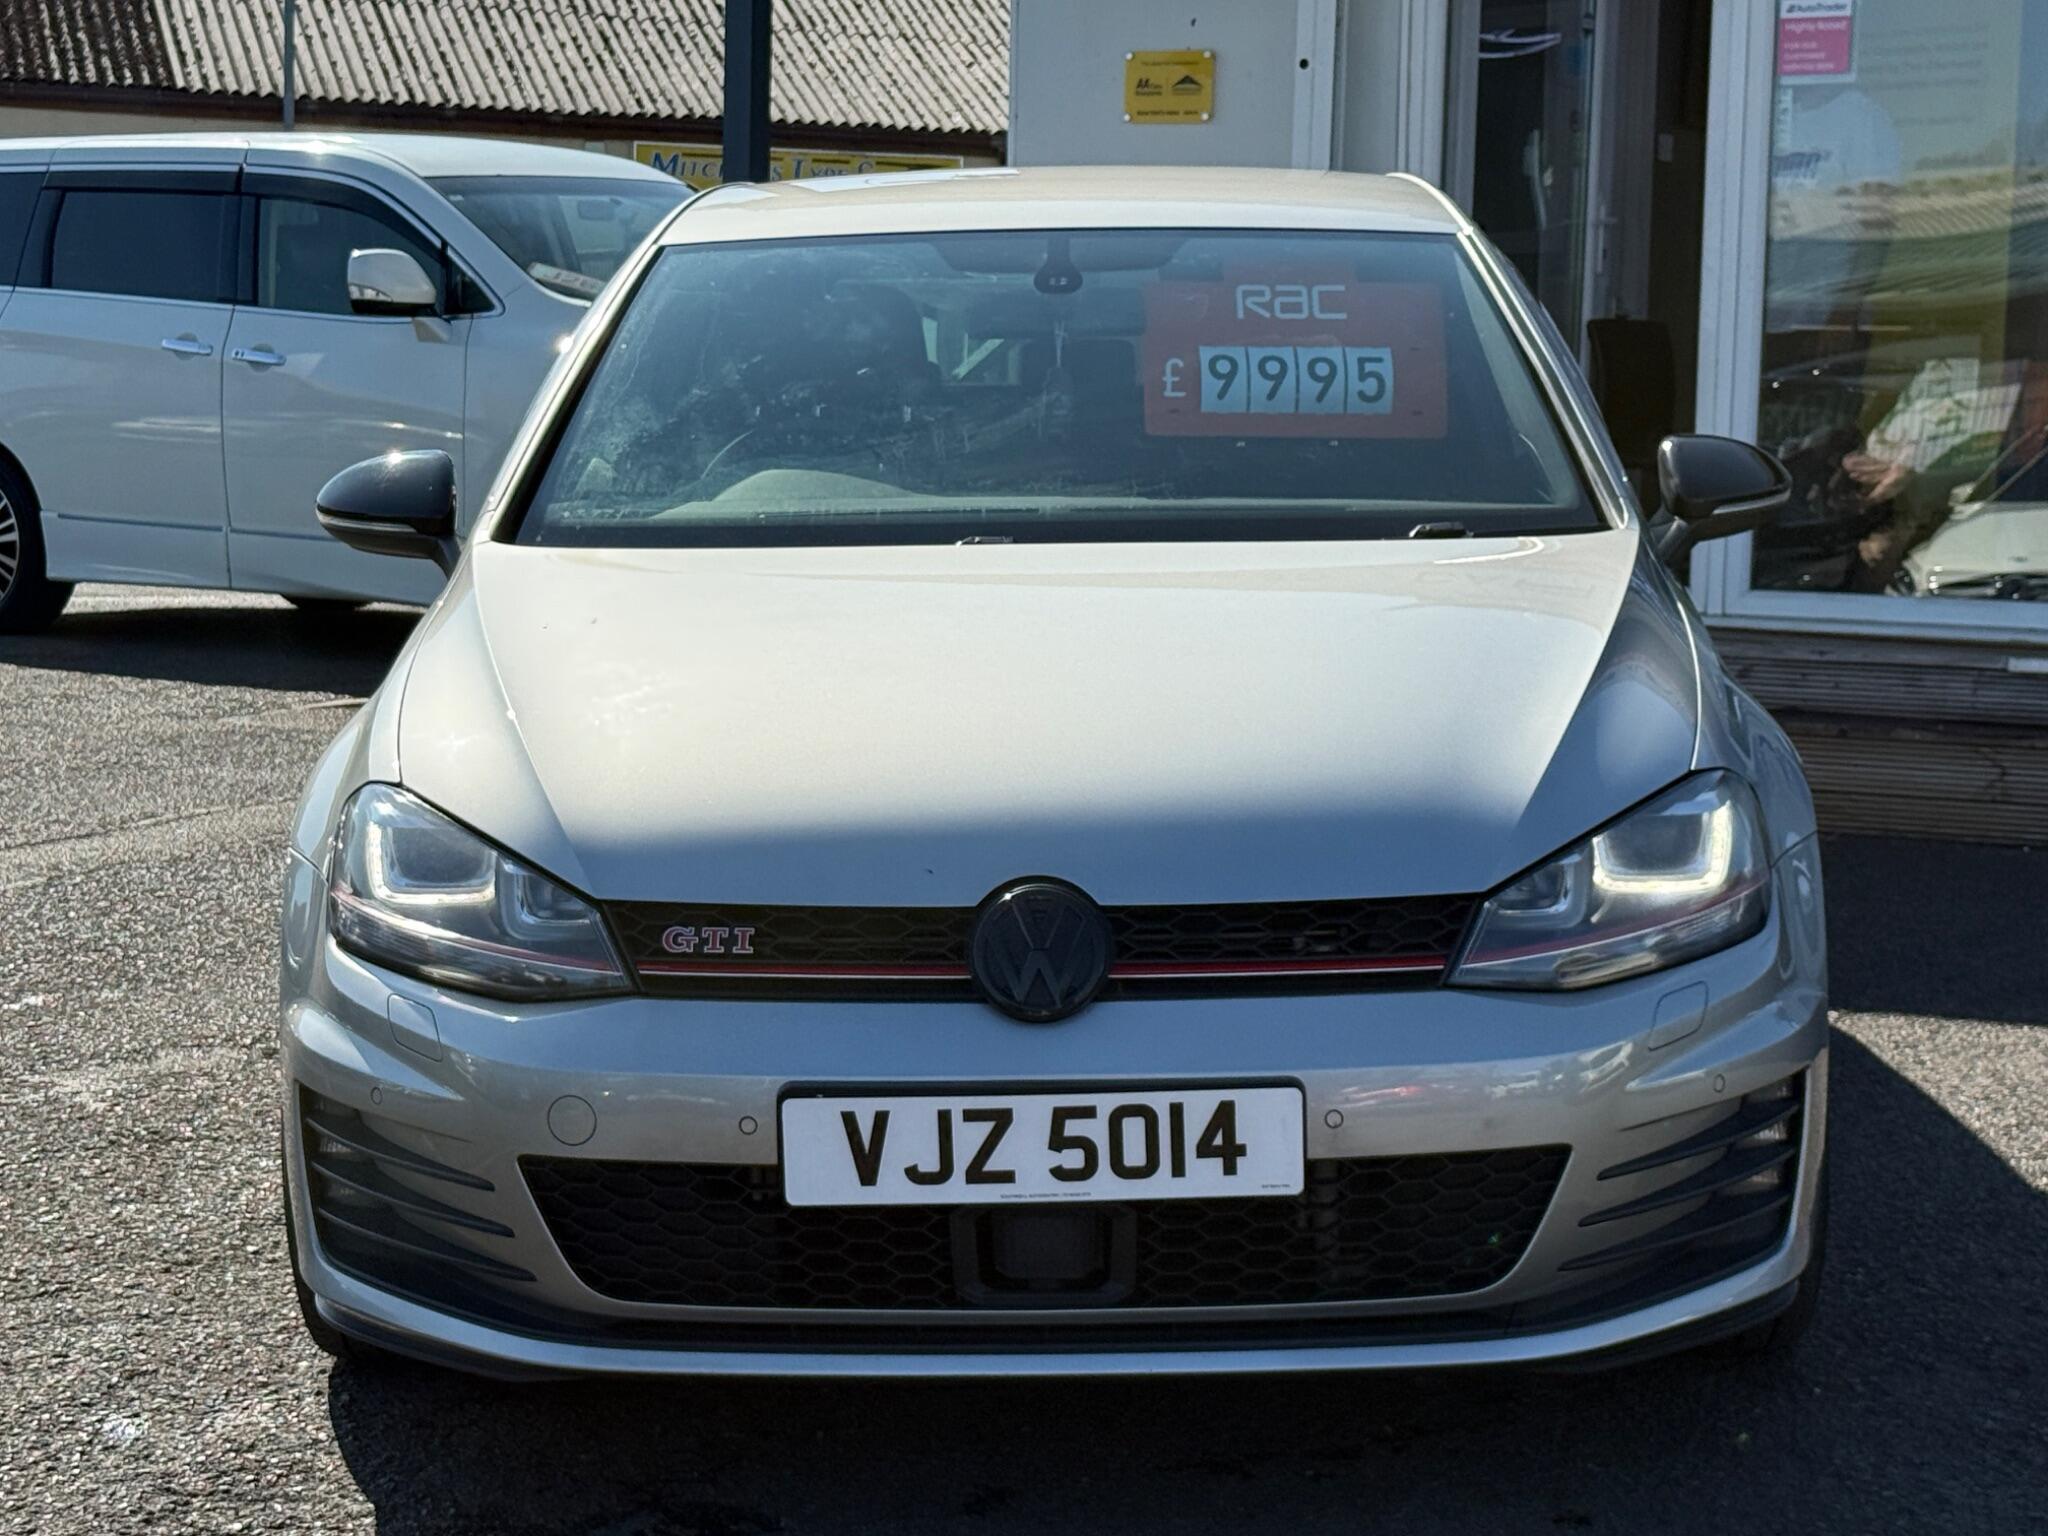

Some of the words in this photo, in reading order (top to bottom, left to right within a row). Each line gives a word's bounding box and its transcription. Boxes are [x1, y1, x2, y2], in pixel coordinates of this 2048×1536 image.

[1207, 353, 1387, 404] 9995
[661, 925, 756, 955] GTI
[840, 1107, 1017, 1187] VJZ
[1048, 1099, 1248, 1182] 5014
